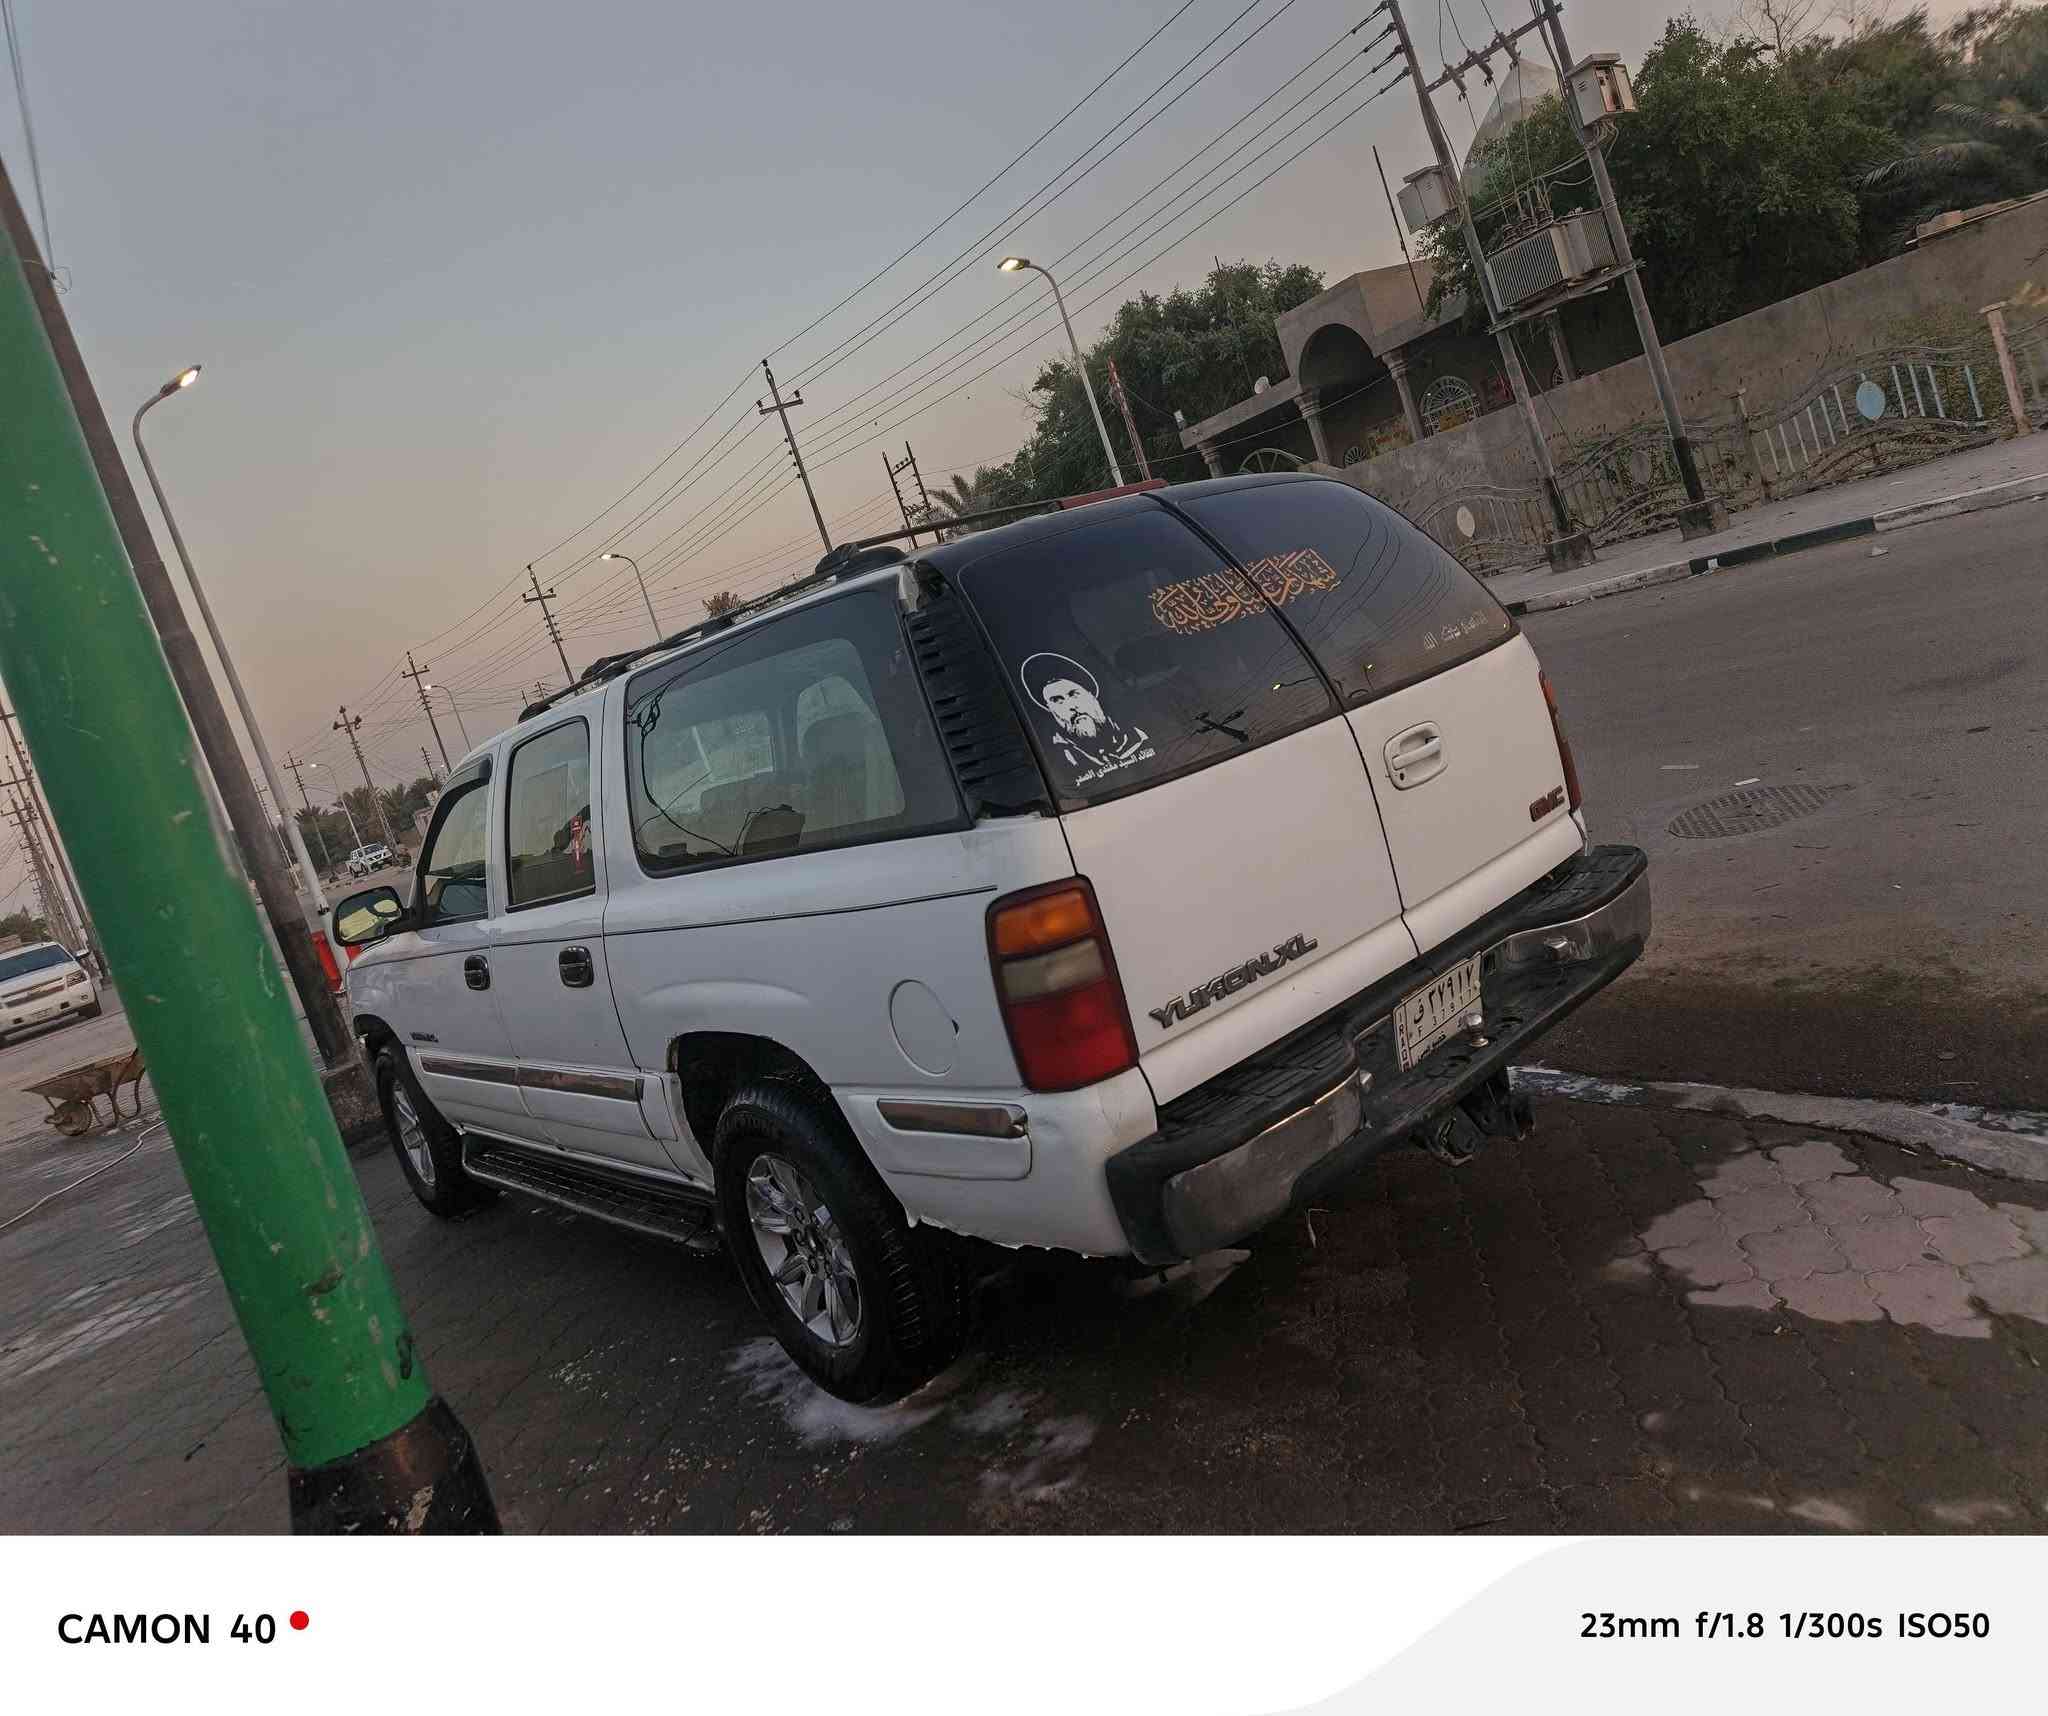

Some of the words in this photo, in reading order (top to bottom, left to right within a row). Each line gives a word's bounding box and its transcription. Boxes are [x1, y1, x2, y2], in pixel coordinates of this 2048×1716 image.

[1119, 753, 1139, 768] السيد
[1075, 769, 1096, 787] الصدر
[1096, 762, 1119, 778] مقتدى
[1529, 784, 1565, 822] GMC
[1273, 933, 1319, 969] XL
